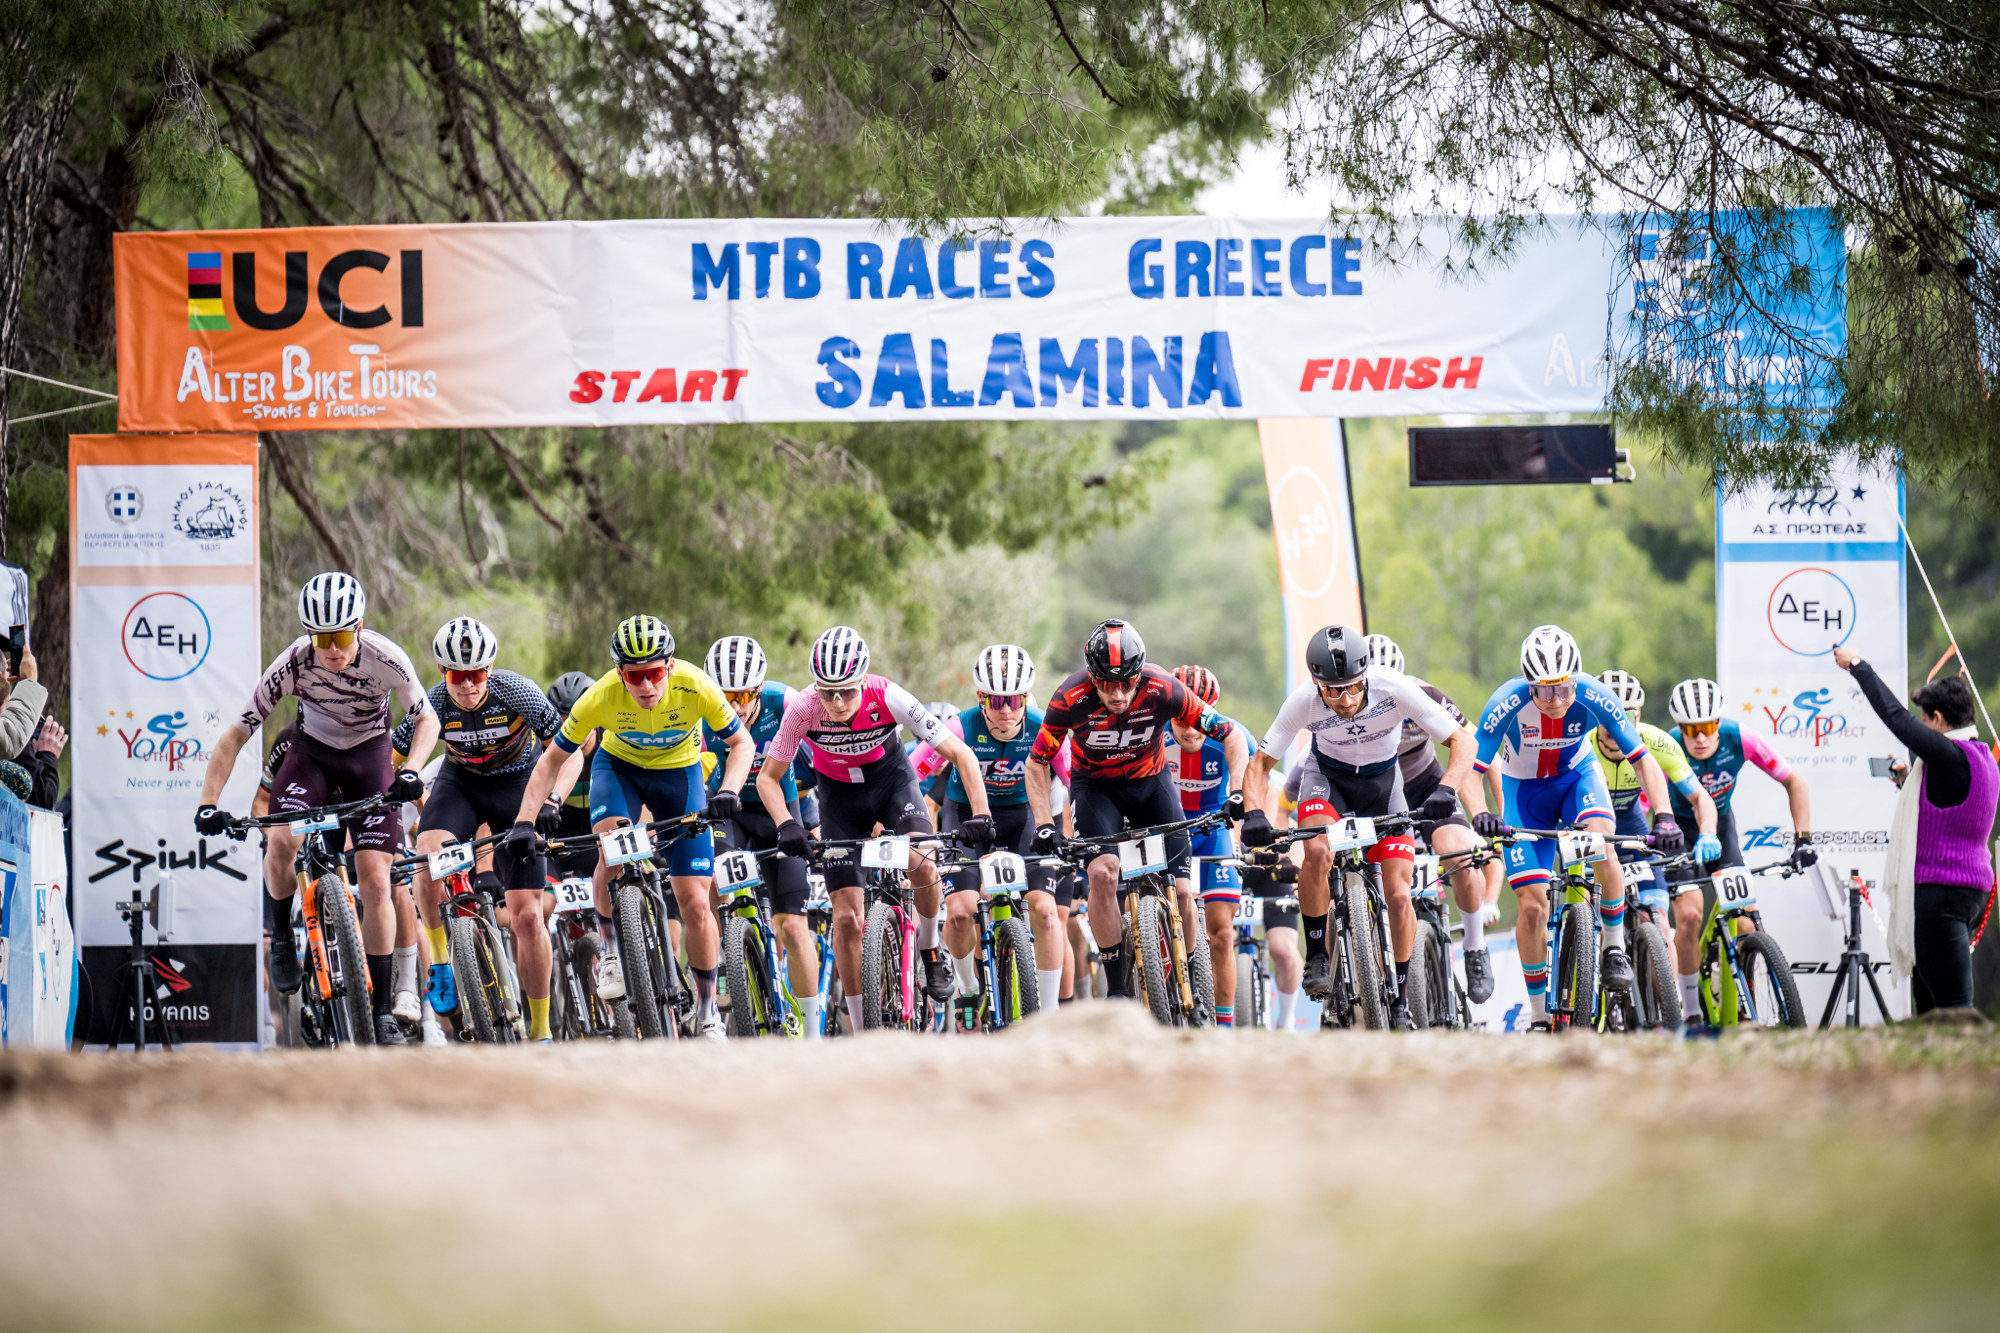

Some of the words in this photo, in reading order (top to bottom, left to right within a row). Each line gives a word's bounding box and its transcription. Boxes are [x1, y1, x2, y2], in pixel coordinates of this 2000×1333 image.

[692, 237, 821, 300] MTB
[847, 237, 1056, 299] RACES
[1129, 235, 1363, 297] GREECE
[232, 249, 423, 330] UCI
[815, 331, 1242, 409] SALAMINA
[1300, 356, 1484, 392] FINISH
[569, 369, 748, 404] START
[308, 402, 318, 418] &
[1787, 522, 1868, 535] ΠΡΩΤΕΑΣ
[1778, 593, 1843, 630] ΔΕΗ
[132, 616, 198, 655] ΔΕΗ
[265, 656, 303, 695] ZEFAL
[460, 731, 498, 740] MENTE
[465, 739, 496, 747] NERO
[1086, 725, 1156, 747] BH
[1813, 754, 1839, 767] give
[1841, 755, 1857, 766] up
[126, 777, 162, 788] Never
[166, 777, 191, 790] give
[1305, 803, 1324, 813] HD
[614, 831, 639, 856] 11
[879, 840, 893, 861] 8
[1134, 840, 1148, 866] 1
[1570, 834, 1596, 859] 12
[438, 848, 465, 870] 25
[724, 854, 748, 884] 15
[990, 856, 1016, 884] 18
[564, 884, 590, 903] 35
[1722, 875, 1749, 901] 60
